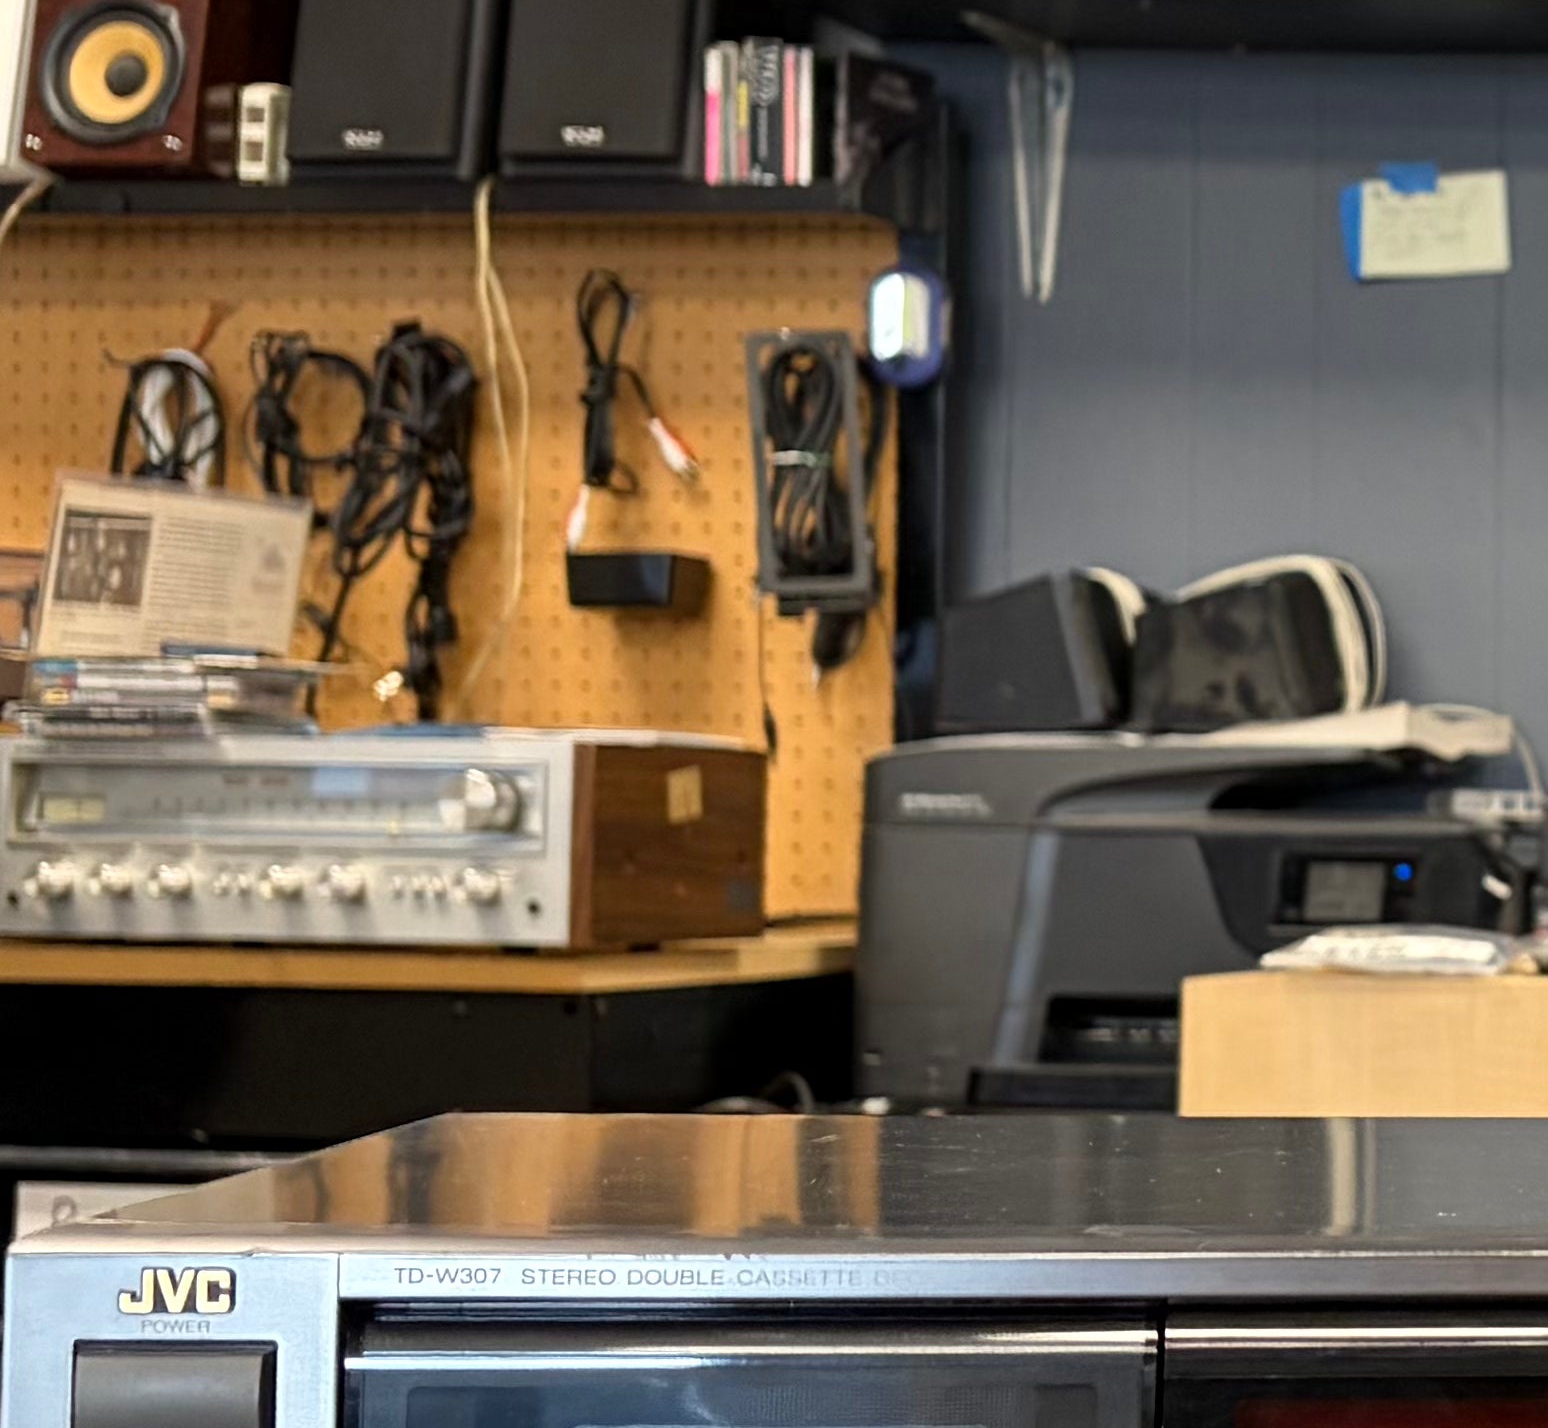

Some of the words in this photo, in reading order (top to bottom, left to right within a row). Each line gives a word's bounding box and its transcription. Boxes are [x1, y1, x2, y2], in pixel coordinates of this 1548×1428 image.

[393, 1266, 501, 1286] TD-W307
[521, 1267, 617, 1287] STEREO
[626, 1267, 725, 1287] DOUBLE
[738, 1268, 862, 1288] CASSETTE
[118, 1267, 236, 1314] JVC
[140, 1319, 211, 1334] POWER
